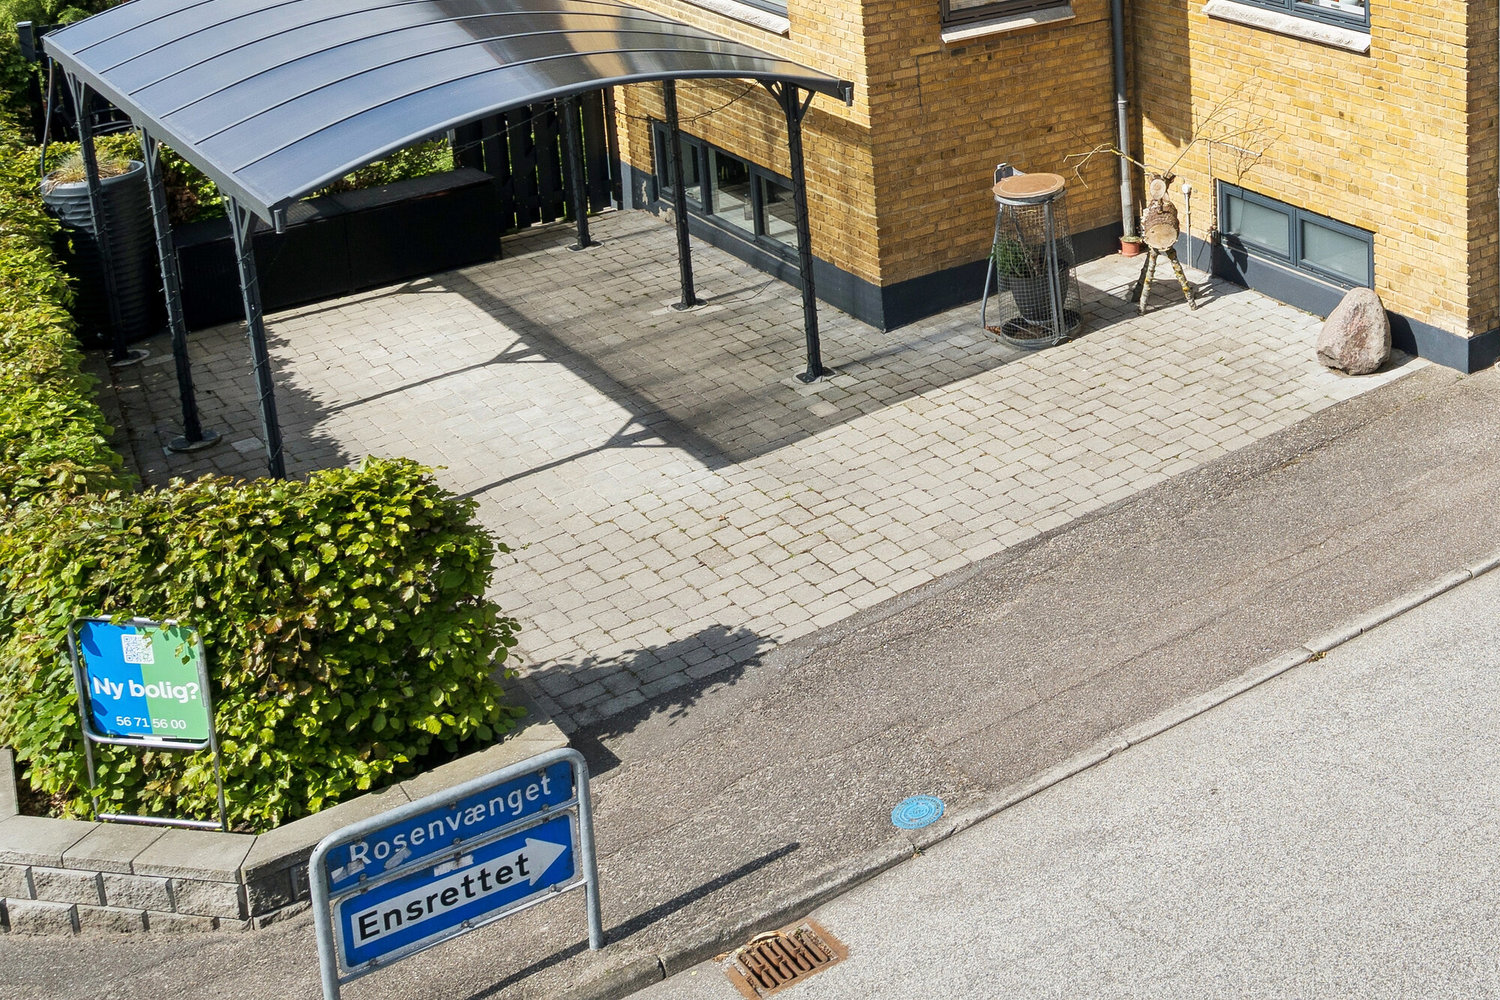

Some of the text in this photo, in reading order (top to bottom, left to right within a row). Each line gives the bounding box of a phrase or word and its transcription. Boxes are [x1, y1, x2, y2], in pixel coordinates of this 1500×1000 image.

[92, 676, 200, 703] Ny bolig?
[116, 716, 187, 730] 56 71 56 00
[350, 775, 551, 865] Rosenvænget
[358, 853, 530, 941] Ensrettet
